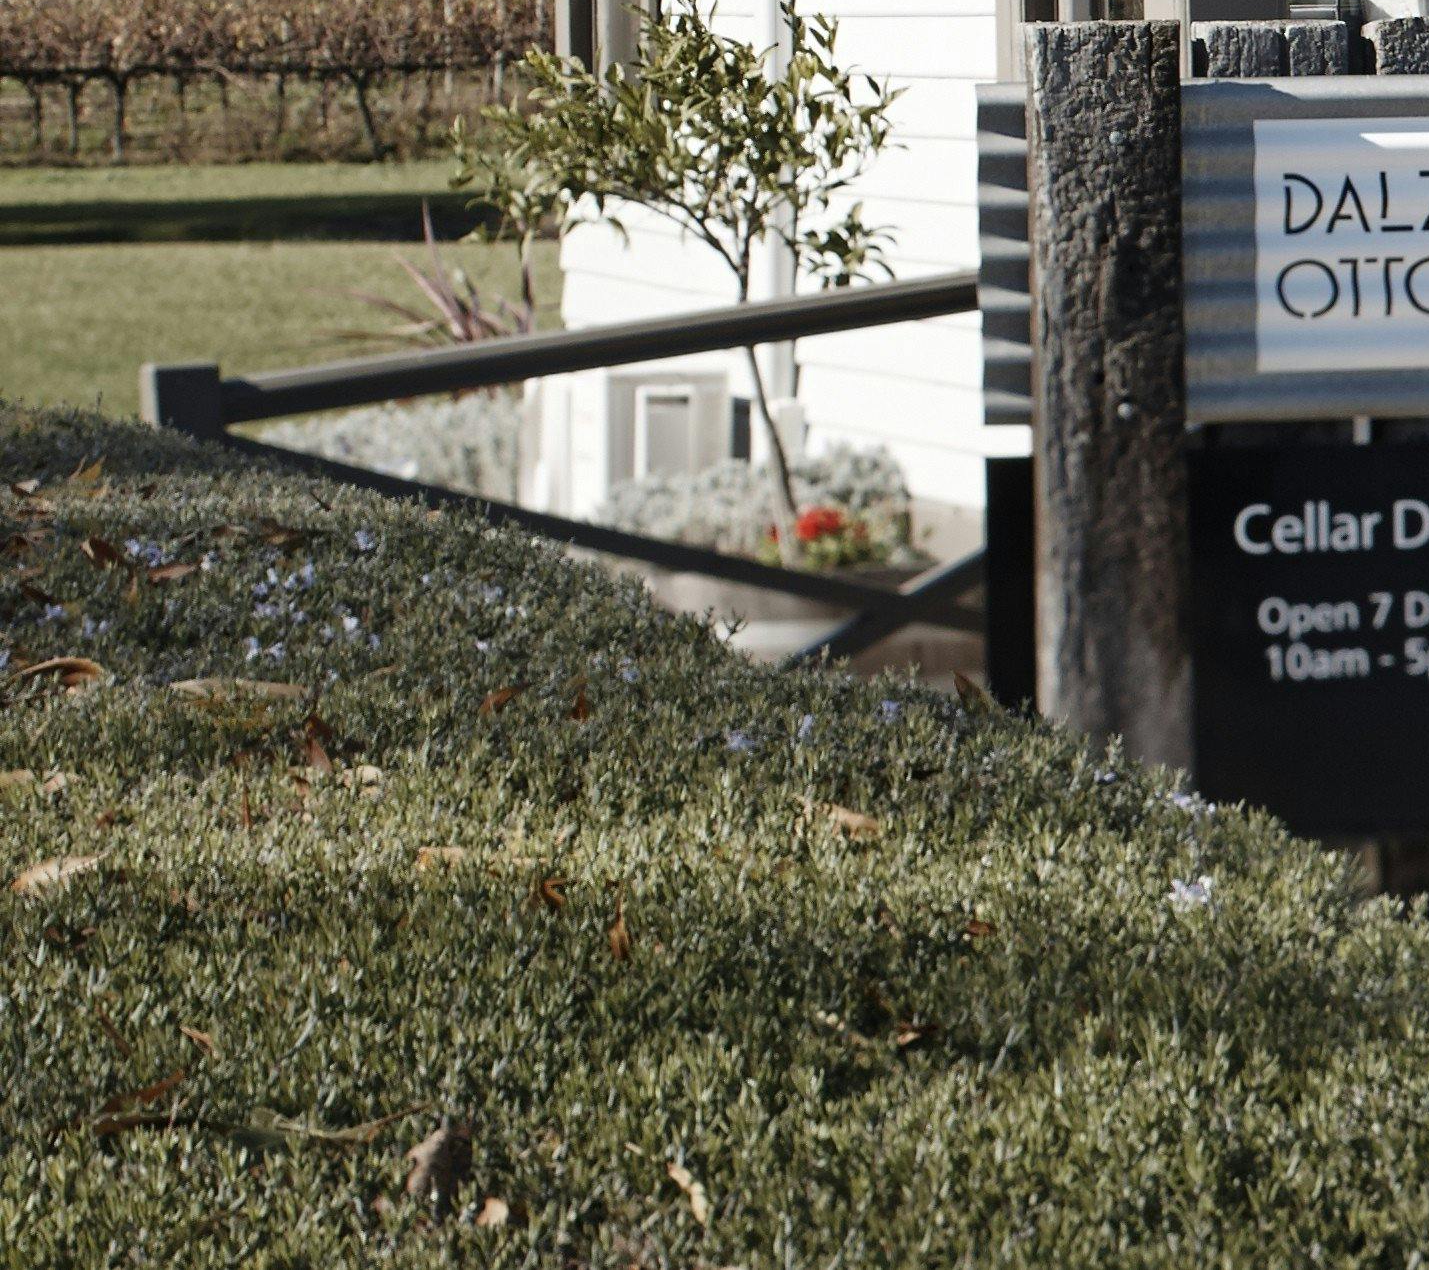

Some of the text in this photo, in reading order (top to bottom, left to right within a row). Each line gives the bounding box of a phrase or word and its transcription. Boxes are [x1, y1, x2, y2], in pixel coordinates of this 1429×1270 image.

[1234, 499, 1382, 555] Cellar
[1257, 596, 1360, 641] Open
[1367, 591, 1394, 630] 7
[1265, 642, 1371, 681] 10am
